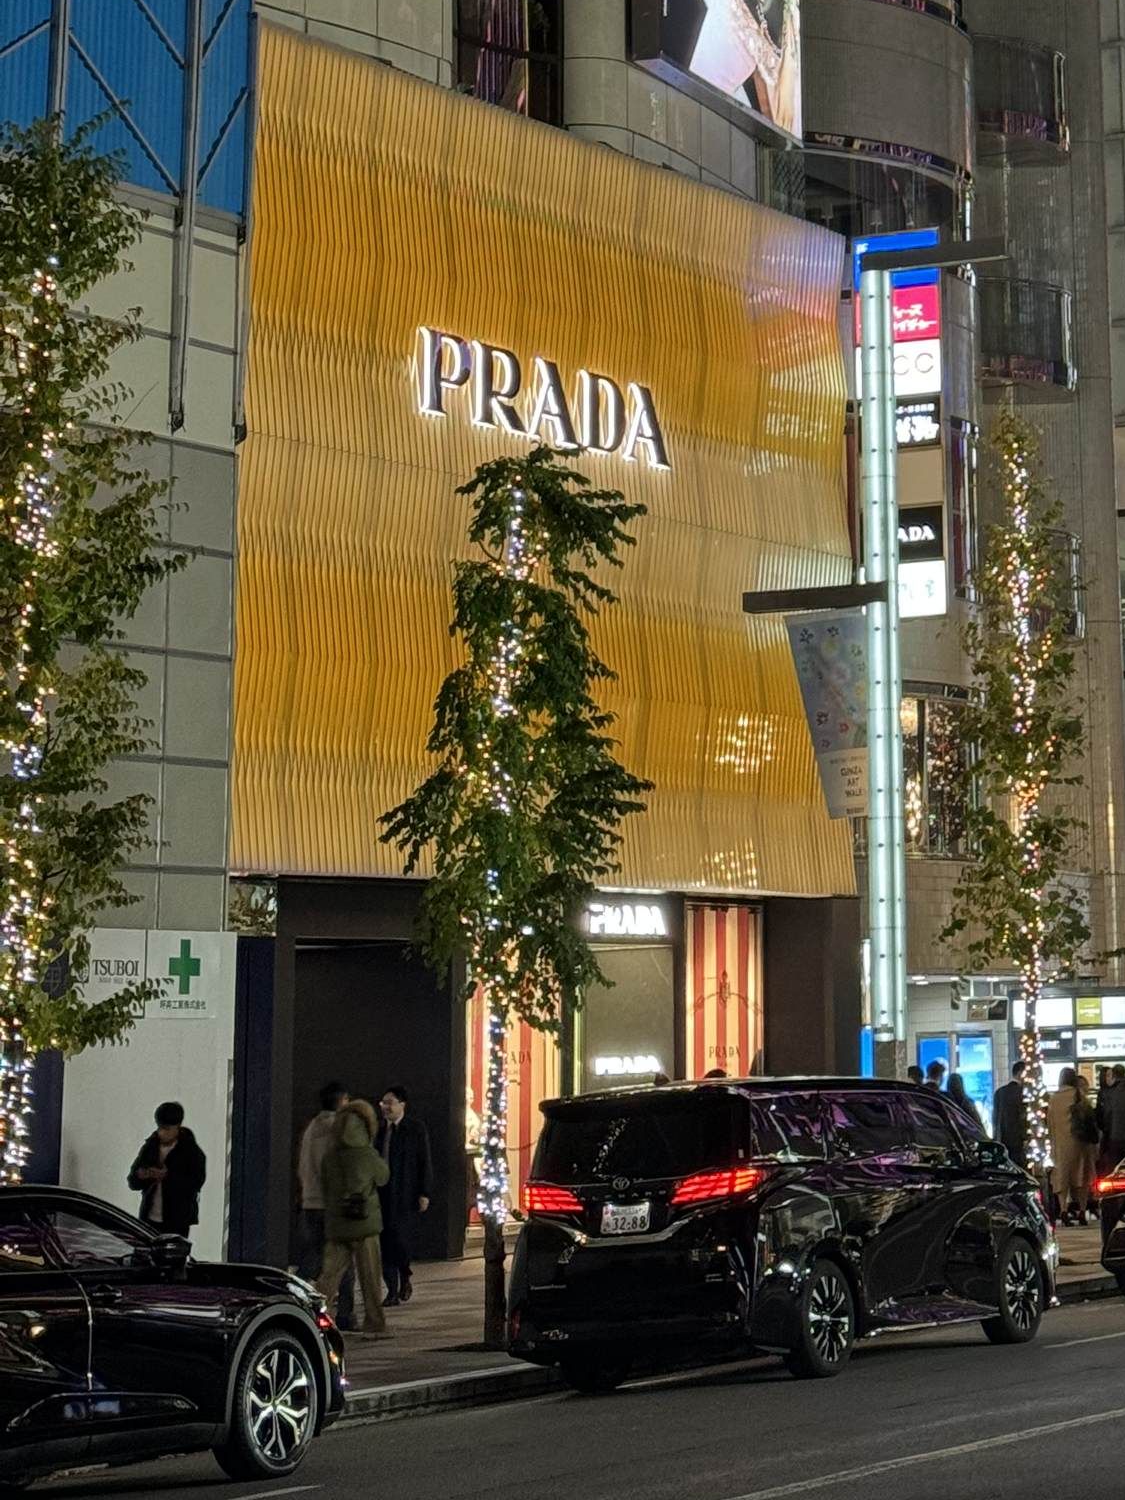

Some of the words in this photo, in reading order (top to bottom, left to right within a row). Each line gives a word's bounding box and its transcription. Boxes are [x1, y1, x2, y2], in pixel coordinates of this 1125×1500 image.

[417, 325, 671, 470] PRADA
[897, 525, 935, 542] ADA
[589, 903, 667, 936] PRADA
[93, 959, 139, 977] TSUBOI
[708, 1045, 741, 1059] PRADA
[595, 1056, 661, 1076] PRADA
